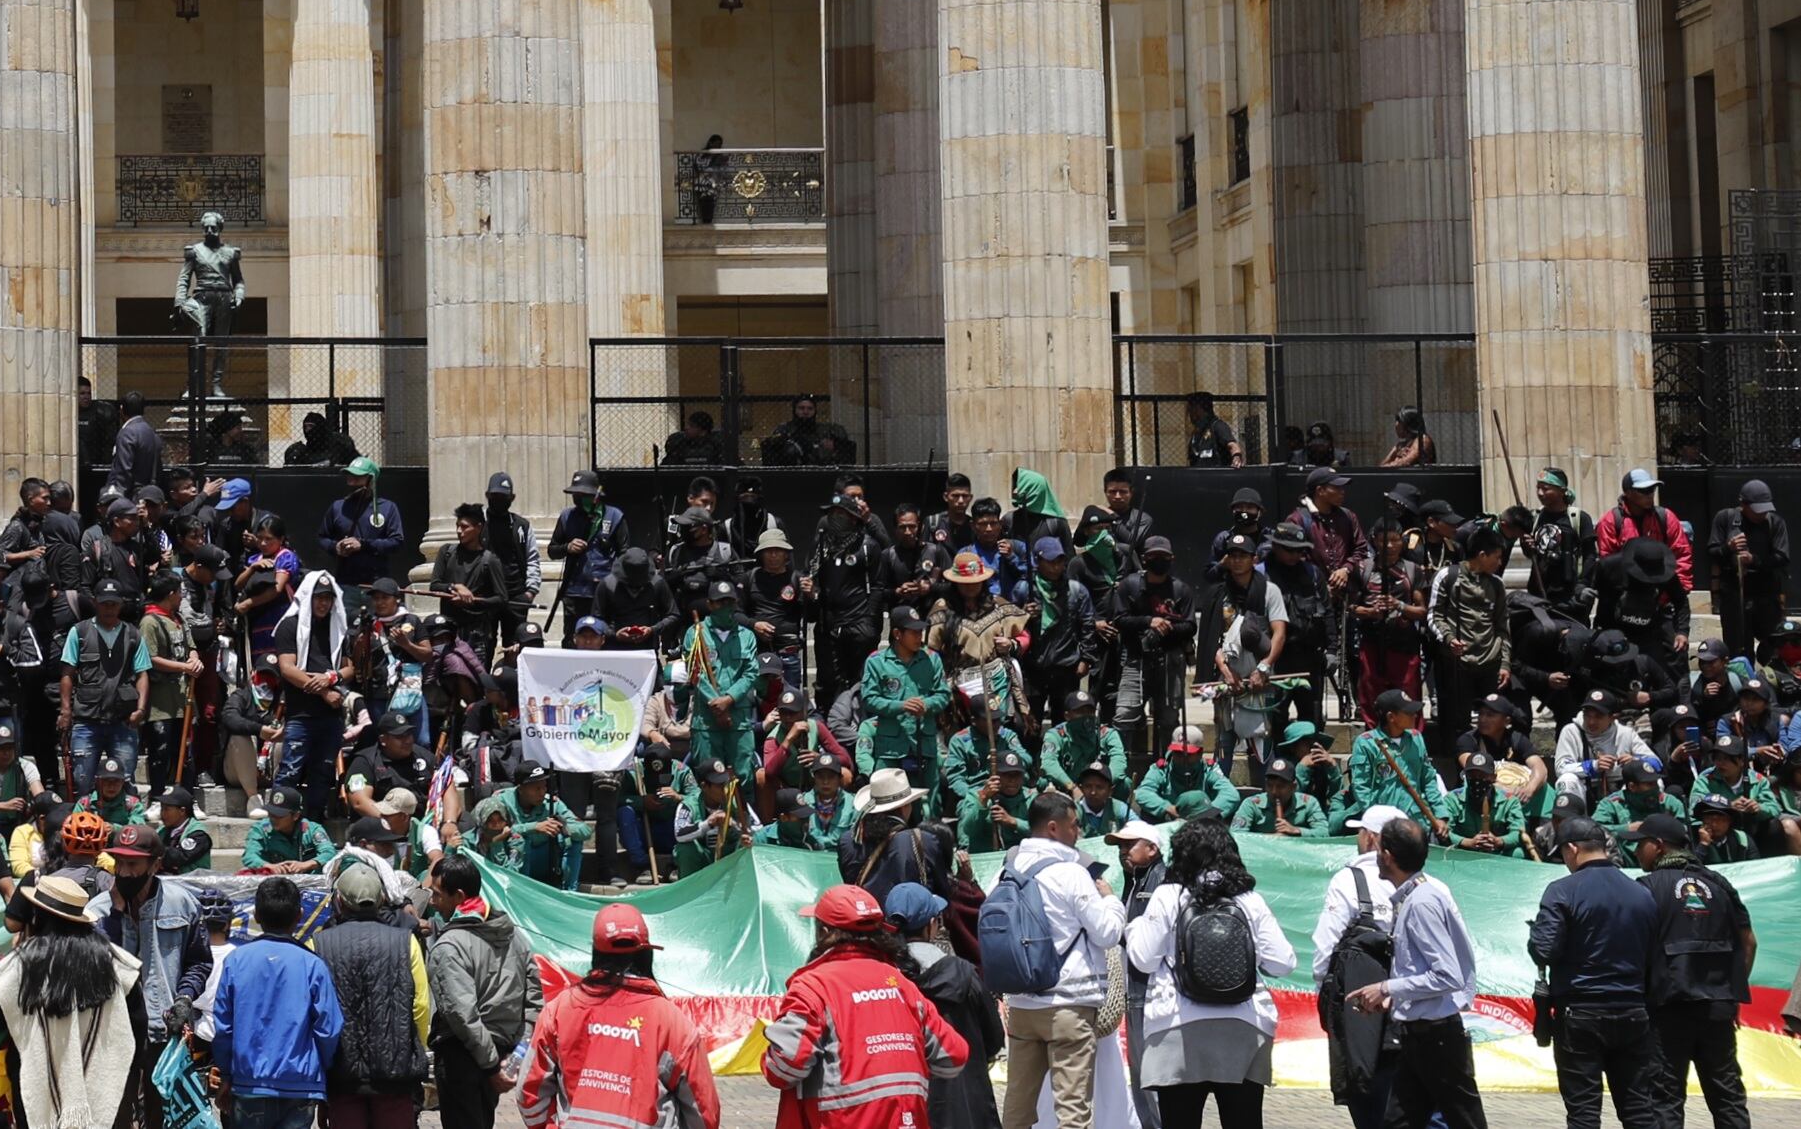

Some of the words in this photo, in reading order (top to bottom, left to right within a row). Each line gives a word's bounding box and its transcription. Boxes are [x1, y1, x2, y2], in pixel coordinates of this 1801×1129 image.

[525, 726, 586, 740] Gobierno
[588, 728, 631, 743] Mayor
[1481, 1003, 1532, 1033] INDÍGEN
[865, 1032, 905, 1045] GESTORES
[620, 1075, 632, 1086] DE
